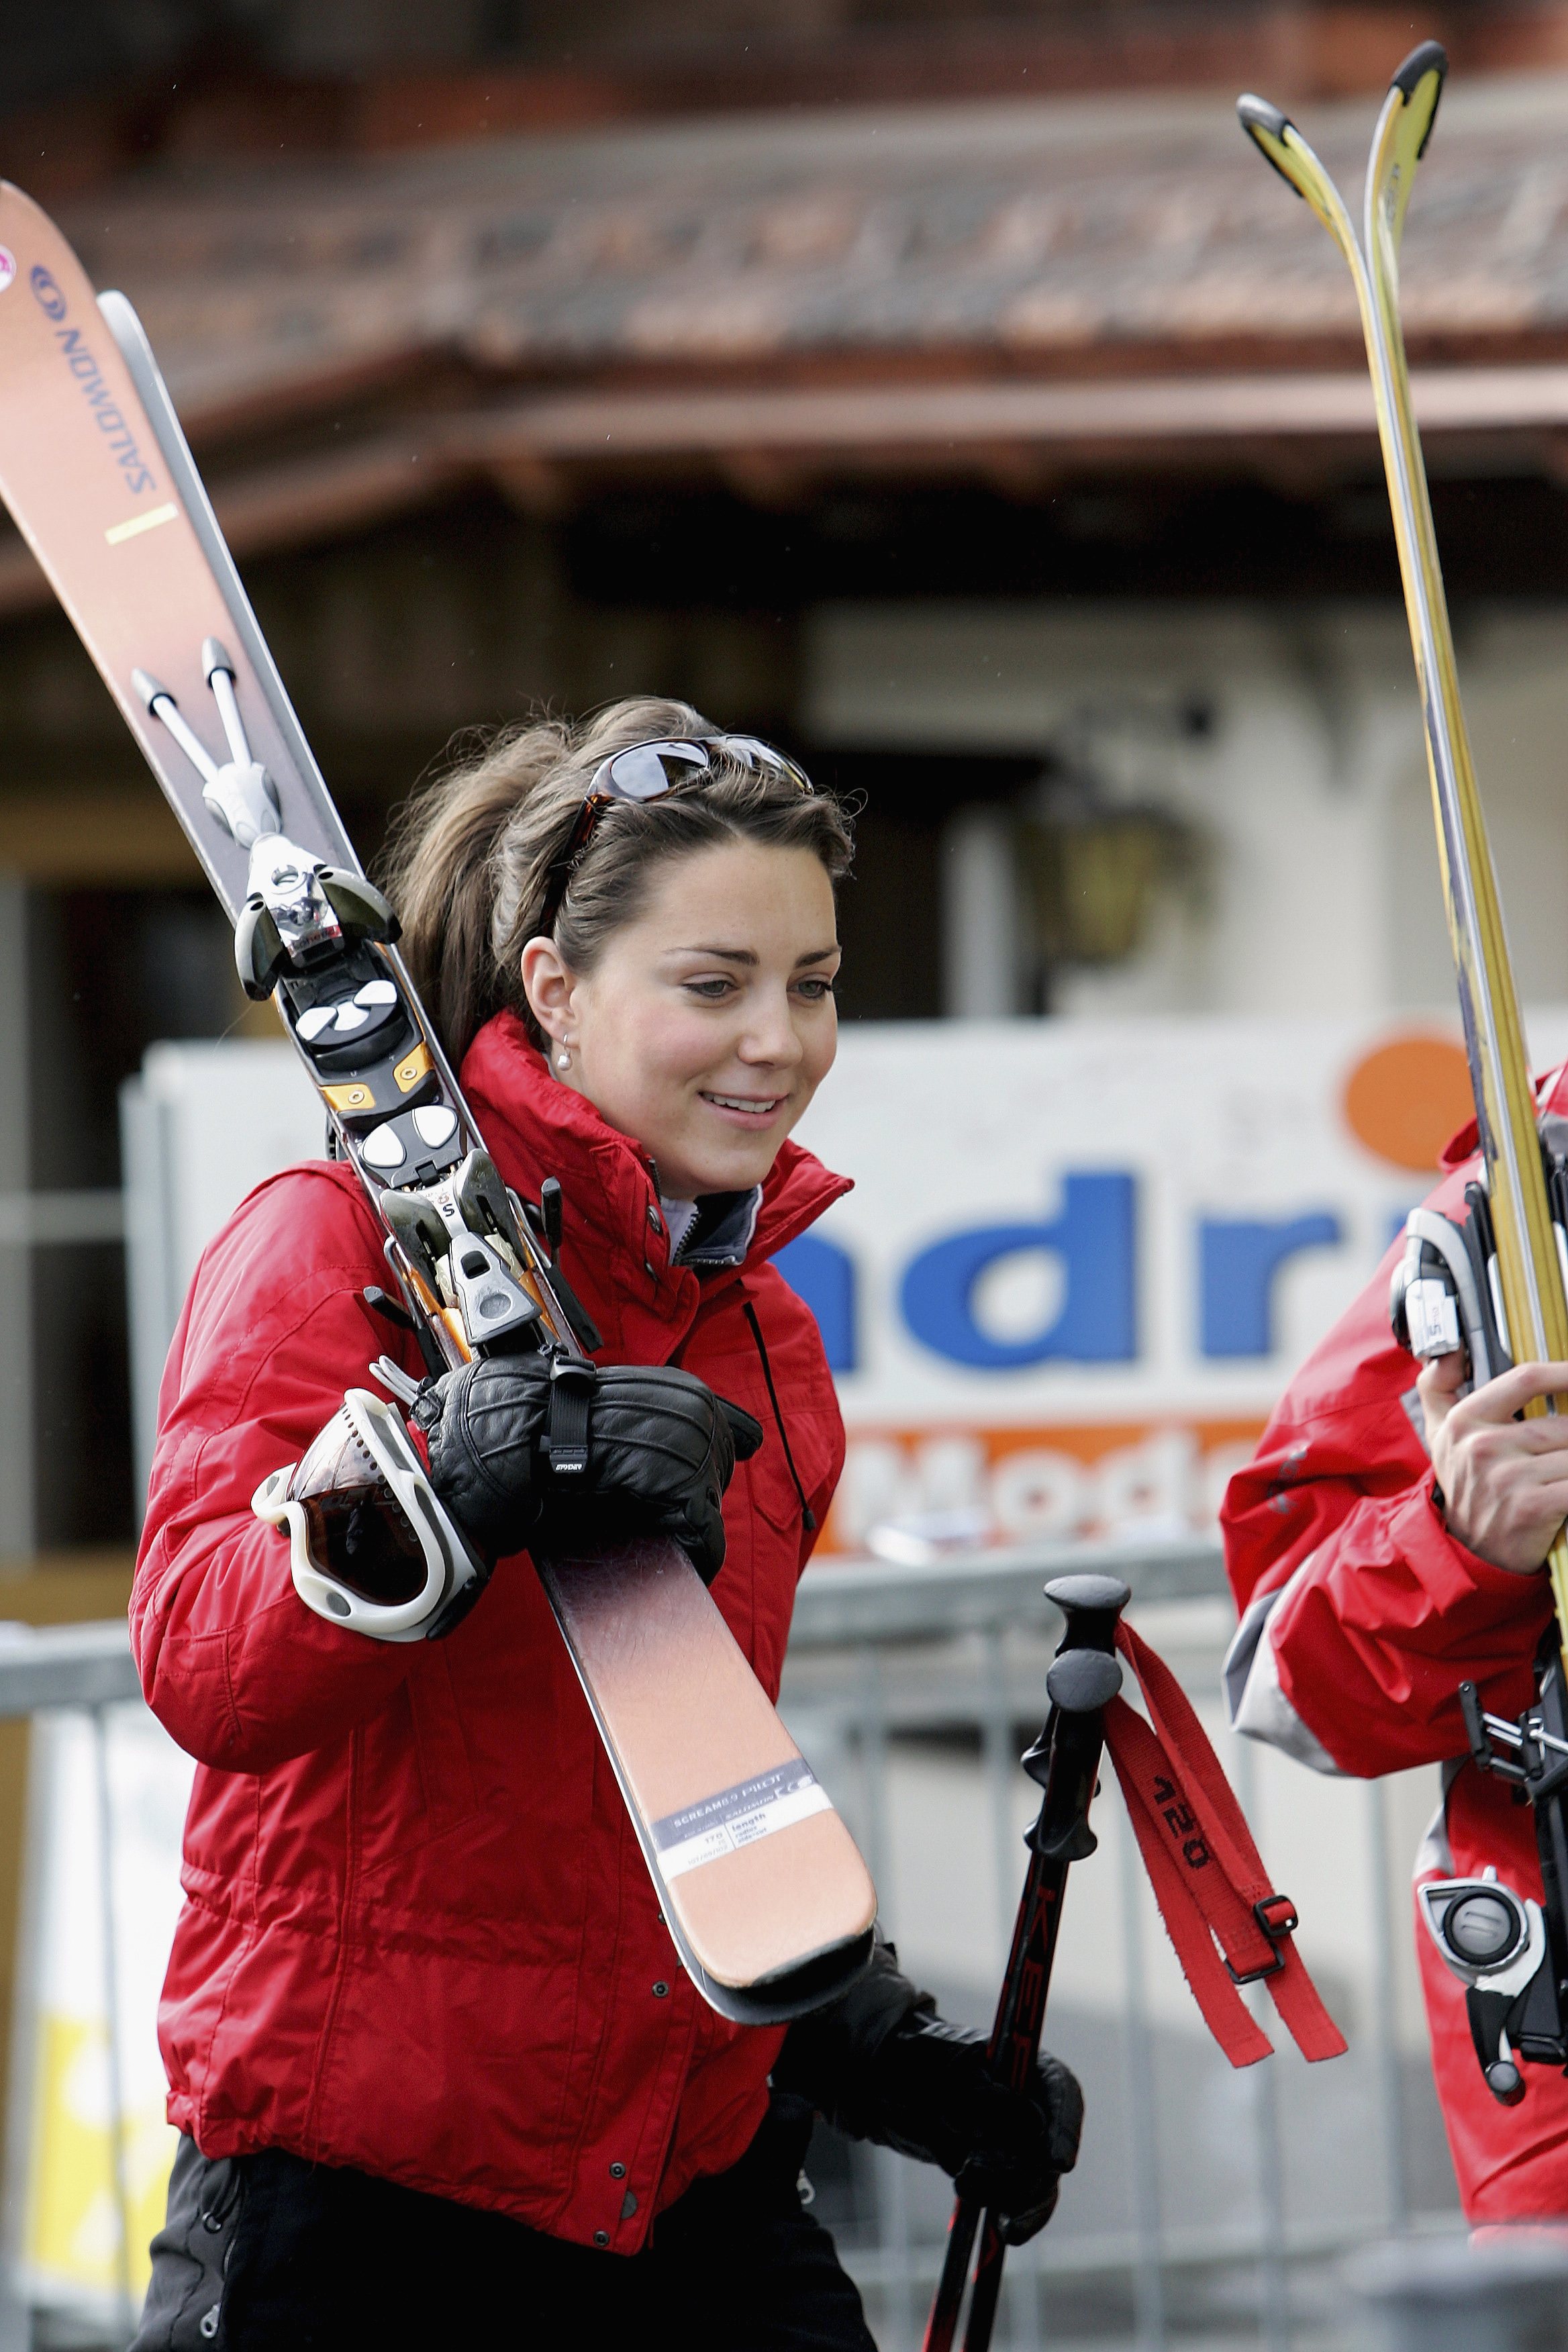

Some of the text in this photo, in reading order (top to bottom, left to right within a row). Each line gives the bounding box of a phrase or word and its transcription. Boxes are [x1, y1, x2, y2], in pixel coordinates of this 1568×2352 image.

[56, 330, 157, 494] SALOMON
[742, 1771, 785, 1797] PILOT
[732, 1812, 767, 1832] length
[1154, 1775, 1210, 1869] 120
